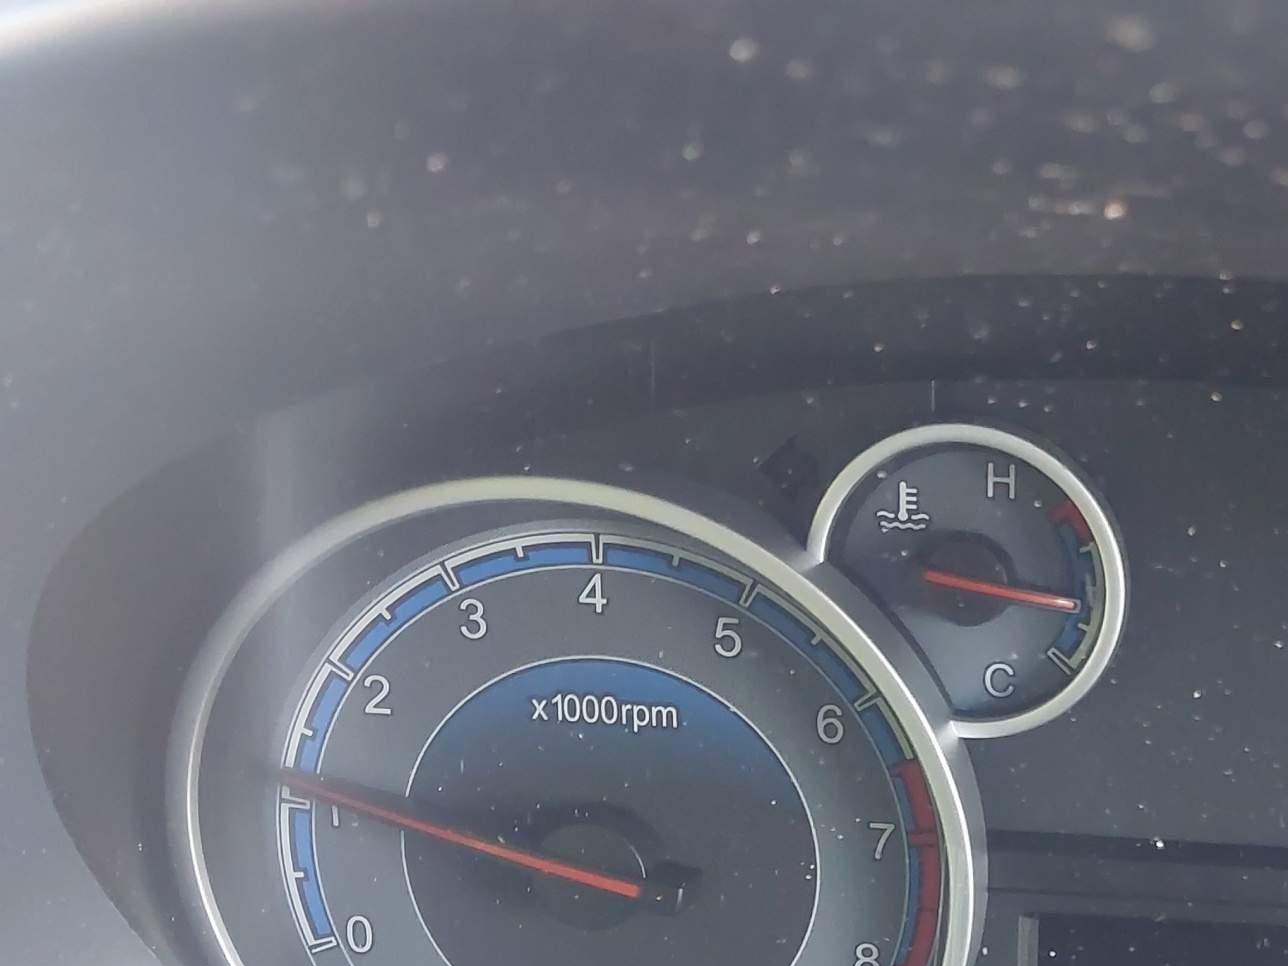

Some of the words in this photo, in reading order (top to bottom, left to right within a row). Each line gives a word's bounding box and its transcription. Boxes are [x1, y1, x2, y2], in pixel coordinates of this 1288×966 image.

[986, 463, 1016, 500] H
[579, 573, 607, 613] 4
[459, 598, 488, 639] 3
[713, 617, 743, 658] 5
[364, 675, 392, 716] 2
[983, 663, 1015, 698] C
[532, 695, 678, 733] x1000rpm
[816, 704, 844, 744] 6
[869, 823, 896, 860] 7
[347, 916, 374, 953] 0
